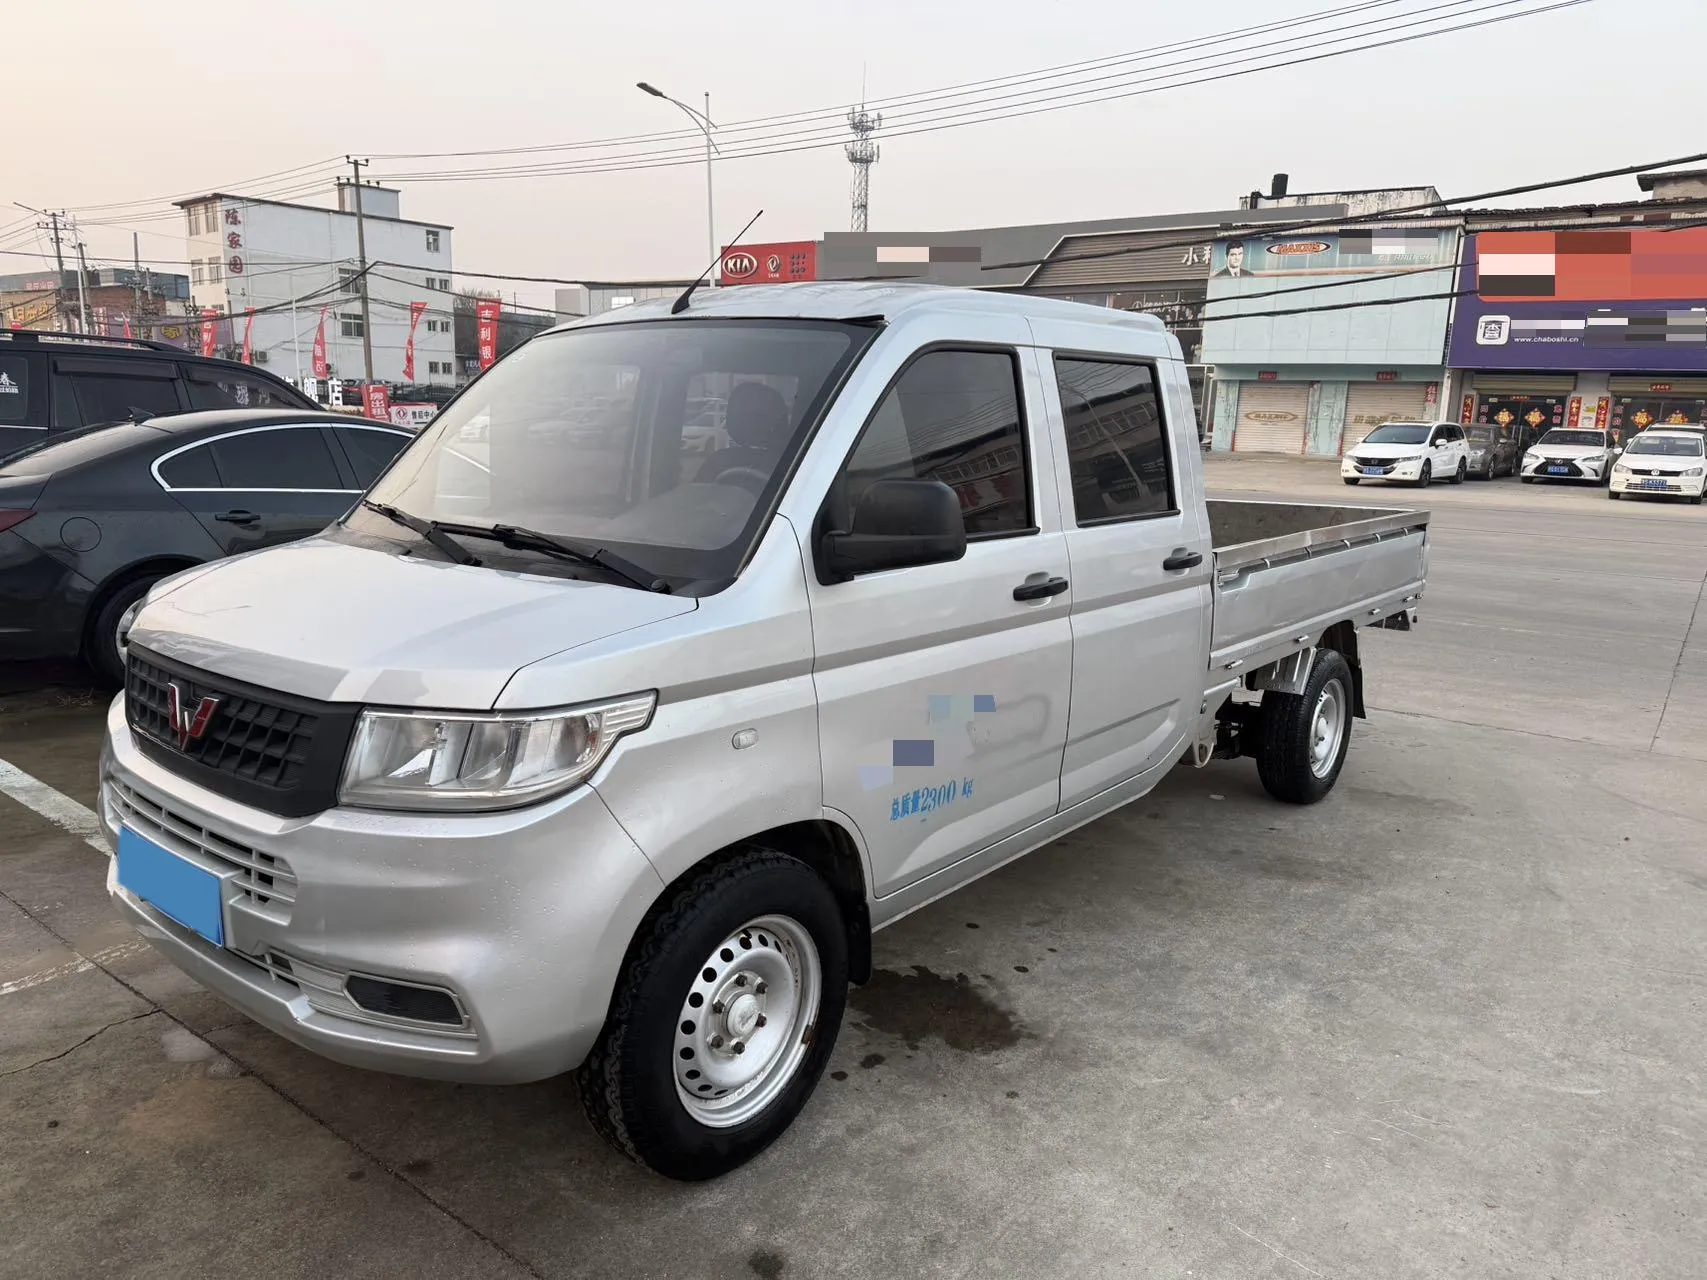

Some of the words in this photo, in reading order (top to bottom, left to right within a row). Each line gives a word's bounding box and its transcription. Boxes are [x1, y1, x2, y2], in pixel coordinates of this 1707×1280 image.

[224, 207, 244, 274] 陈家园
[727, 257, 751, 273] KIA
[480, 308, 495, 369] 吉利银
